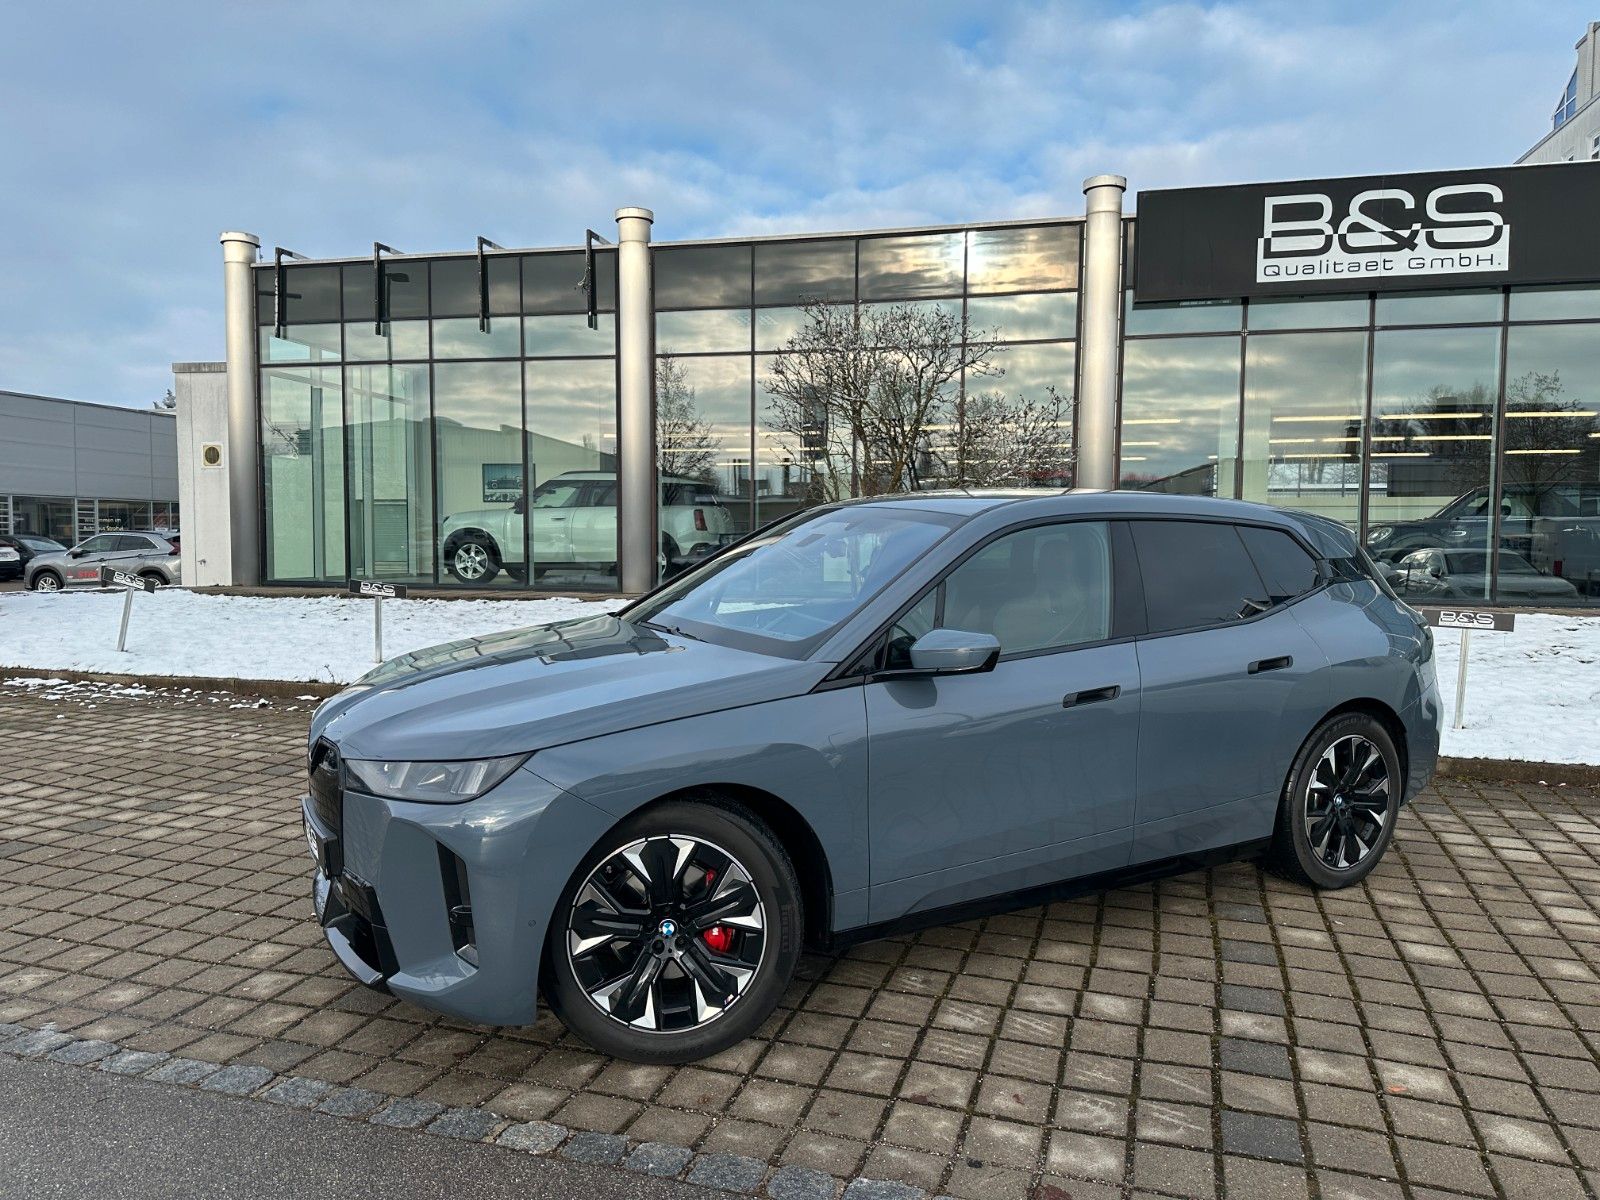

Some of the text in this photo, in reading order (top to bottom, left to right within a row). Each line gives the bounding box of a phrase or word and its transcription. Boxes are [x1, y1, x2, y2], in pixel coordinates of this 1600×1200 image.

[1263, 183, 1503, 258] B&S
[1263, 253, 1502, 277] Qualitaet GmbH.
[1440, 611, 1494, 624] B&S
